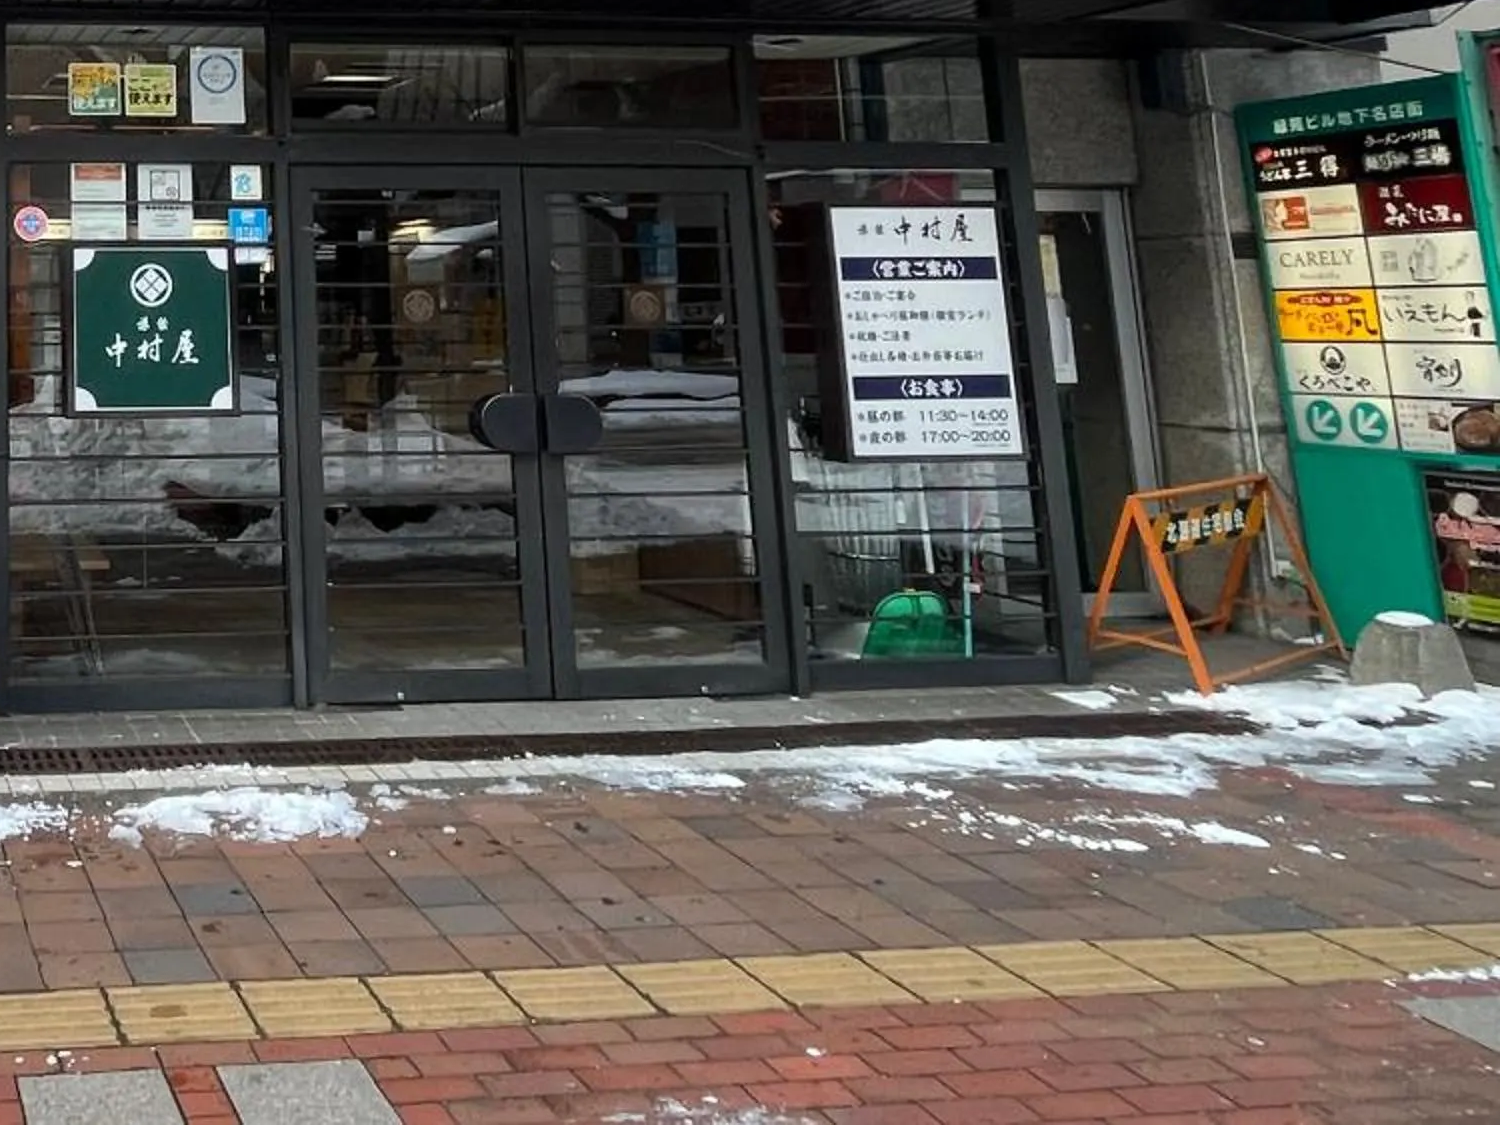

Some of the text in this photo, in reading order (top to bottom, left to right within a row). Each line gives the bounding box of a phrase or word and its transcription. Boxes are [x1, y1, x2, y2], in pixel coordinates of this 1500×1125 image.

[1280, 249, 1354, 268] CARELY
[105, 329, 199, 367] 中村屋
